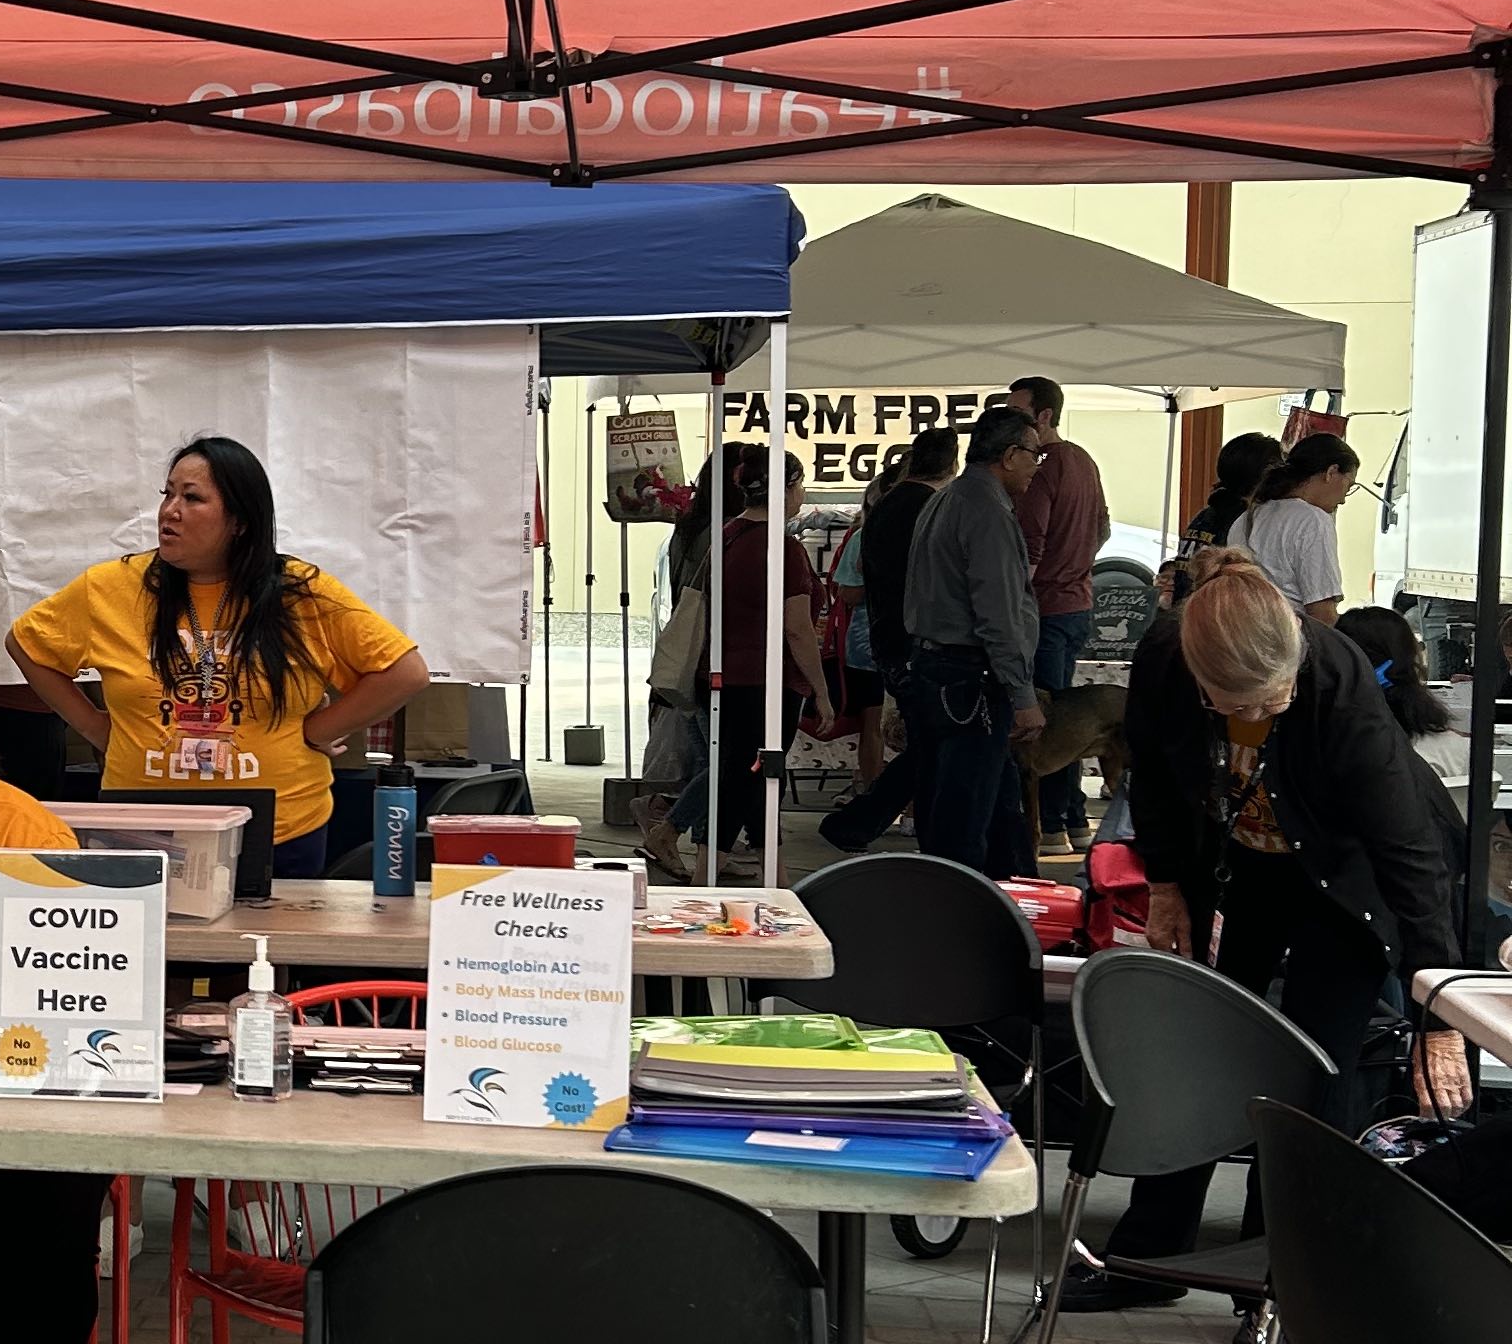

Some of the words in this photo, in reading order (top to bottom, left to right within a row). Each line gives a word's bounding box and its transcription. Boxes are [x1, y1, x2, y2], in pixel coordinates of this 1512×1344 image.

[722, 392, 858, 439] FARM
[1096, 591, 1149, 607] Fresh
[1094, 610, 1146, 621] NUGGETS
[387, 806, 410, 880] nancy
[460, 890, 506, 907] Free
[512, 892, 605, 912] Wellness
[28, 907, 119, 929] COVID
[494, 920, 569, 939] Checks
[11, 946, 128, 971] Vaccine
[456, 957, 548, 974] Hemoglobin
[551, 961, 581, 974] A1C
[37, 988, 108, 1013] Here
[456, 983, 494, 1000] Body
[498, 984, 535, 998] Mass
[539, 988, 581, 1001] Index
[584, 989, 625, 1005] (BMI)
[455, 1009, 499, 1024] Blood
[503, 1011, 568, 1027] Pressure
[13, 1038, 31, 1049] No
[454, 1035, 498, 1050] Blood
[501, 1037, 563, 1054] Glucose
[7, 1056, 38, 1066] Cost!
[562, 1085, 580, 1097] No
[554, 1101, 586, 1113] Cost!
